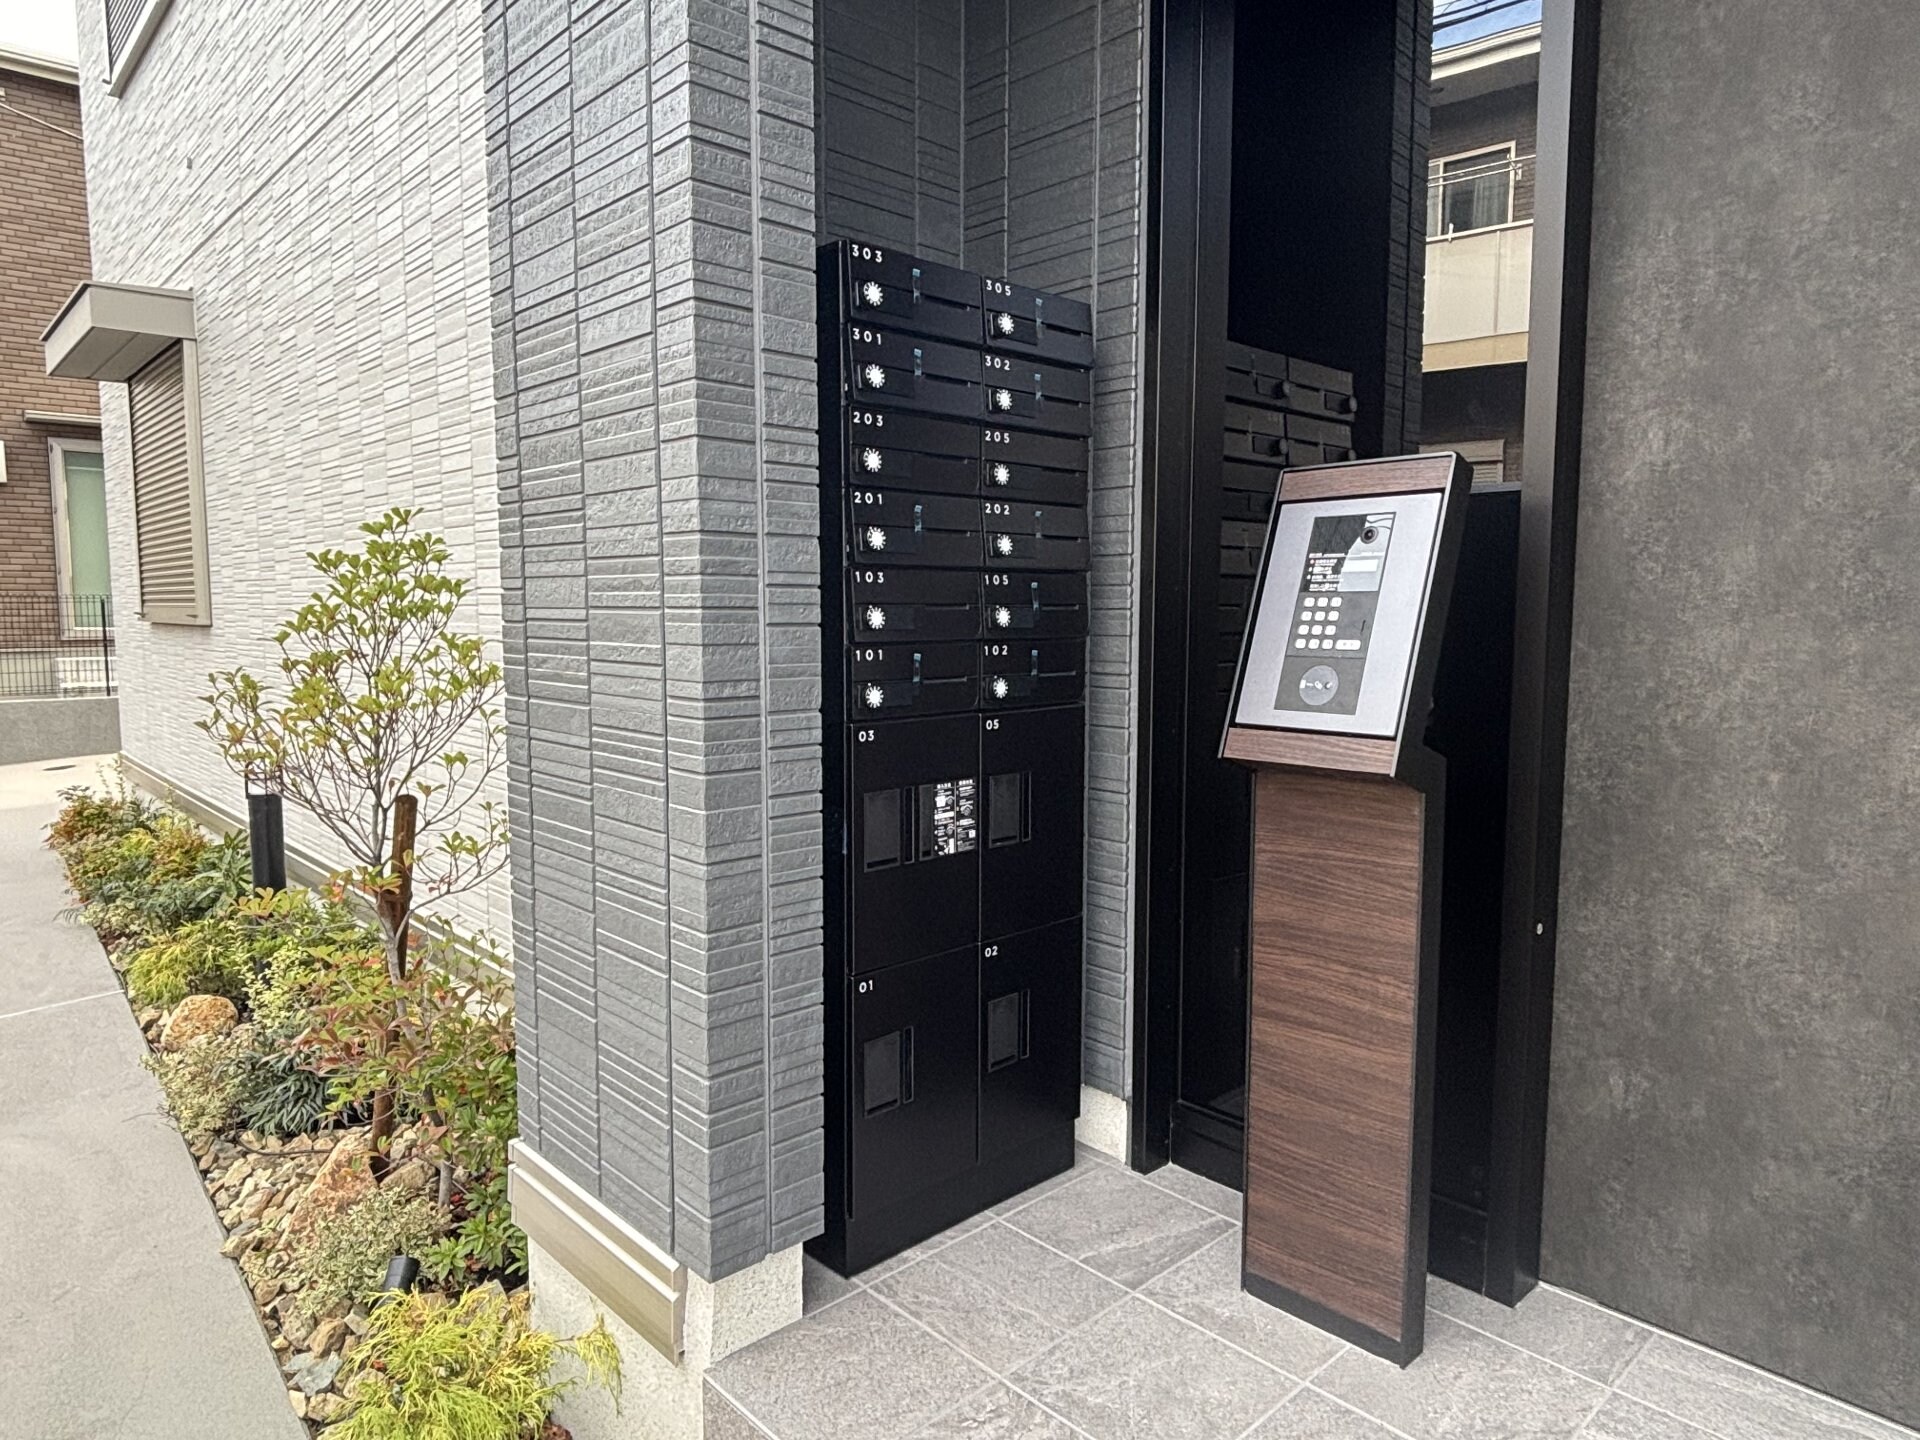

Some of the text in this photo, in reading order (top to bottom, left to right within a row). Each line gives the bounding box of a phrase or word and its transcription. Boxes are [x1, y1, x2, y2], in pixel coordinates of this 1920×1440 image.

[852, 244, 883, 262] 303
[985, 279, 1012, 296] 305
[852, 328, 882, 346] 301
[984, 355, 1011, 371] 302
[853, 411, 884, 427] 203
[984, 431, 1010, 444] 205
[853, 492, 883, 505] 201
[984, 503, 1011, 516] 202
[854, 571, 884, 584] 103
[984, 574, 1009, 586] 105
[855, 649, 883, 662] 101
[983, 645, 1008, 656] 102
[985, 719, 1000, 730] 05
[858, 730, 875, 743] 03
[984, 946, 998, 958] 02
[858, 980, 873, 994] 01
